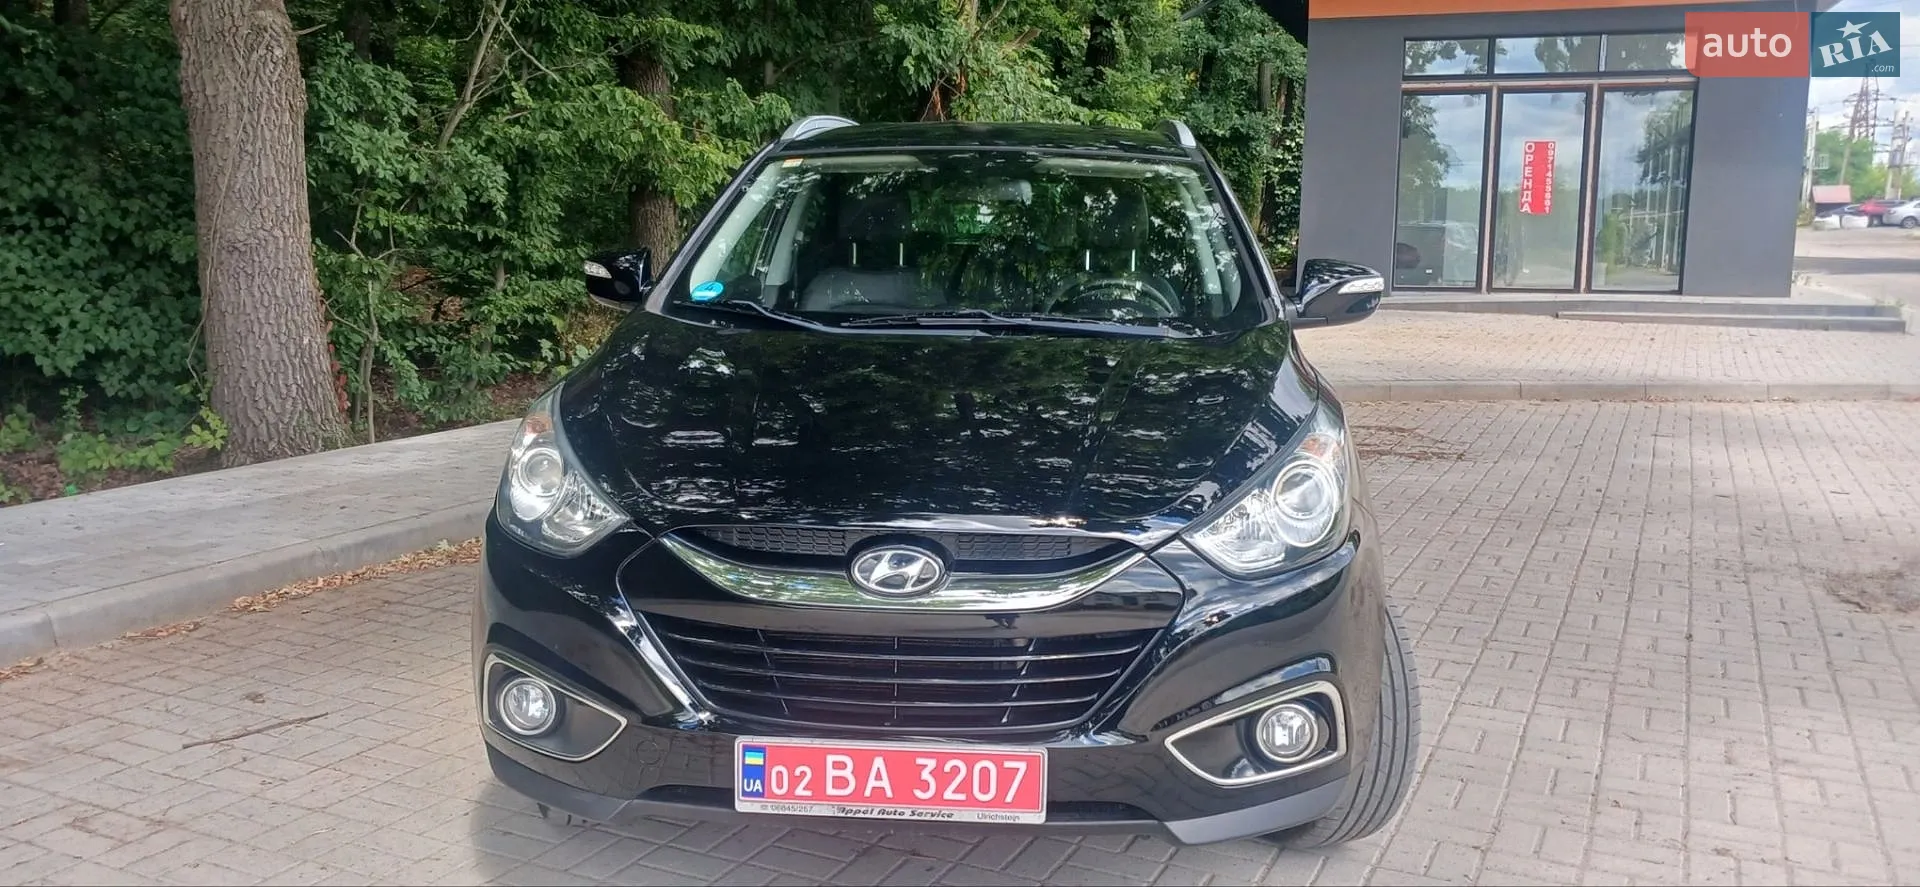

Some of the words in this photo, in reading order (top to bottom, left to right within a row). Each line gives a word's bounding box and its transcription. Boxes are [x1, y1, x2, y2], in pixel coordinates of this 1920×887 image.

[1520, 142, 1535, 214] ОРЕНДА
[743, 778, 763, 793] UA
[769, 765, 813, 796] 02
[825, 754, 894, 799] BA
[912, 757, 1028, 803] 3207
[877, 808, 906, 817] Auto
[909, 809, 954, 819] Service
